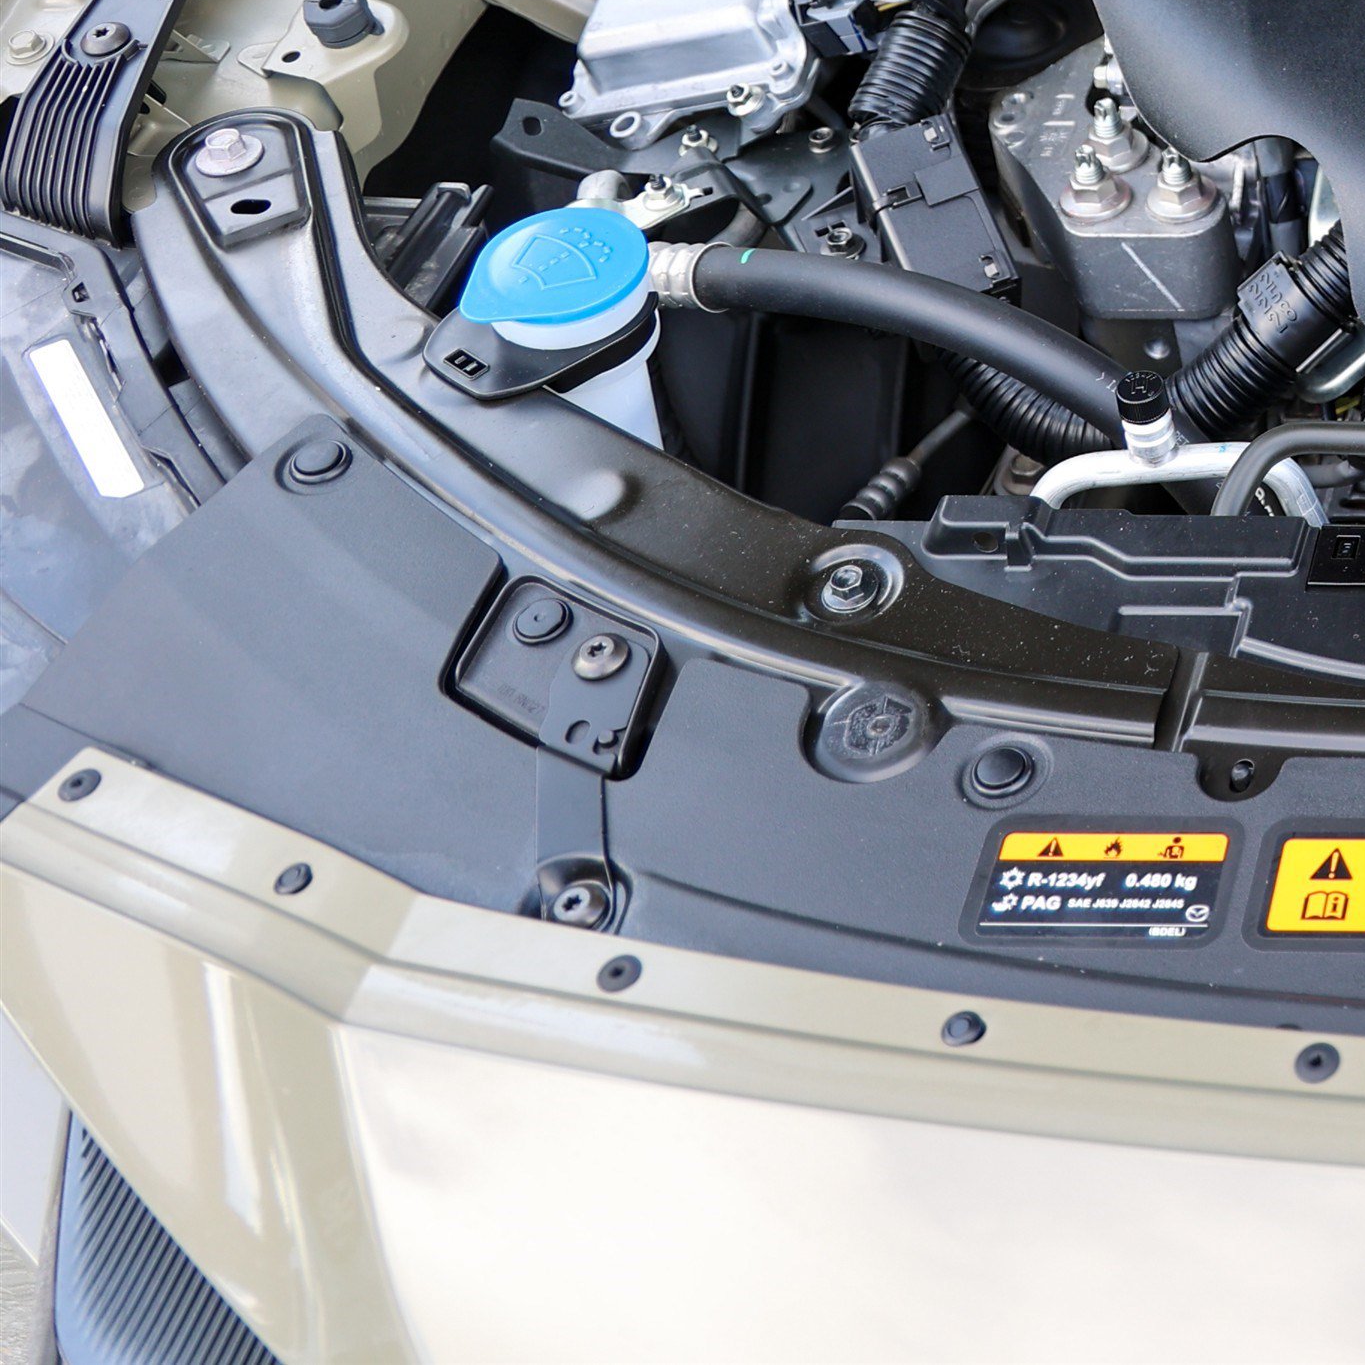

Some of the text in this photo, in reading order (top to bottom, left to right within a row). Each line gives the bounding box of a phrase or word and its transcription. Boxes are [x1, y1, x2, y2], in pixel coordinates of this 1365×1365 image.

[1027, 872, 1199, 892] R-1234yf 0.480 kg
[1020, 895, 1063, 911] PAG
[1067, 898, 1093, 909] SAE
